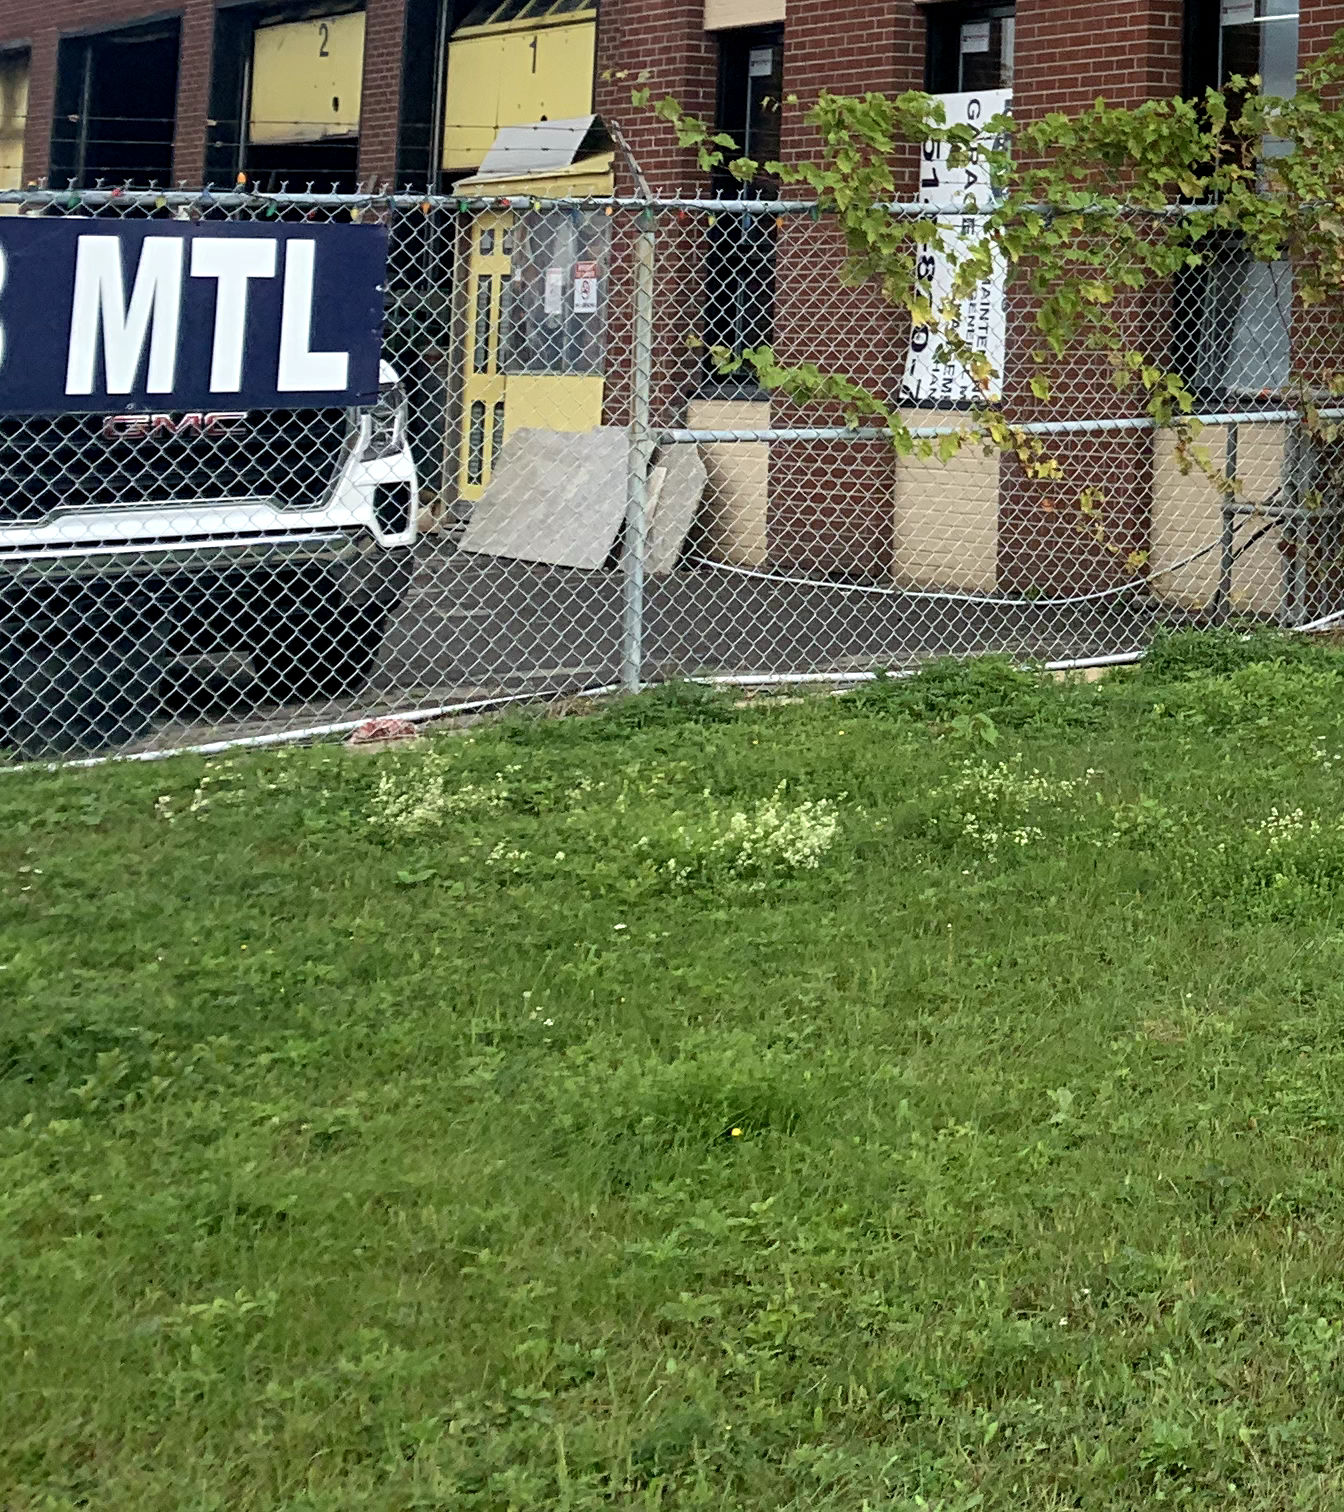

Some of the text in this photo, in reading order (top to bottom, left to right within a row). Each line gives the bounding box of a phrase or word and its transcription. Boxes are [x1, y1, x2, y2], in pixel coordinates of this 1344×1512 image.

[317, 23, 330, 58] 2
[529, 35, 538, 74] 1
[65, 235, 350, 395] MTL
[102, 412, 248, 440] GMC
